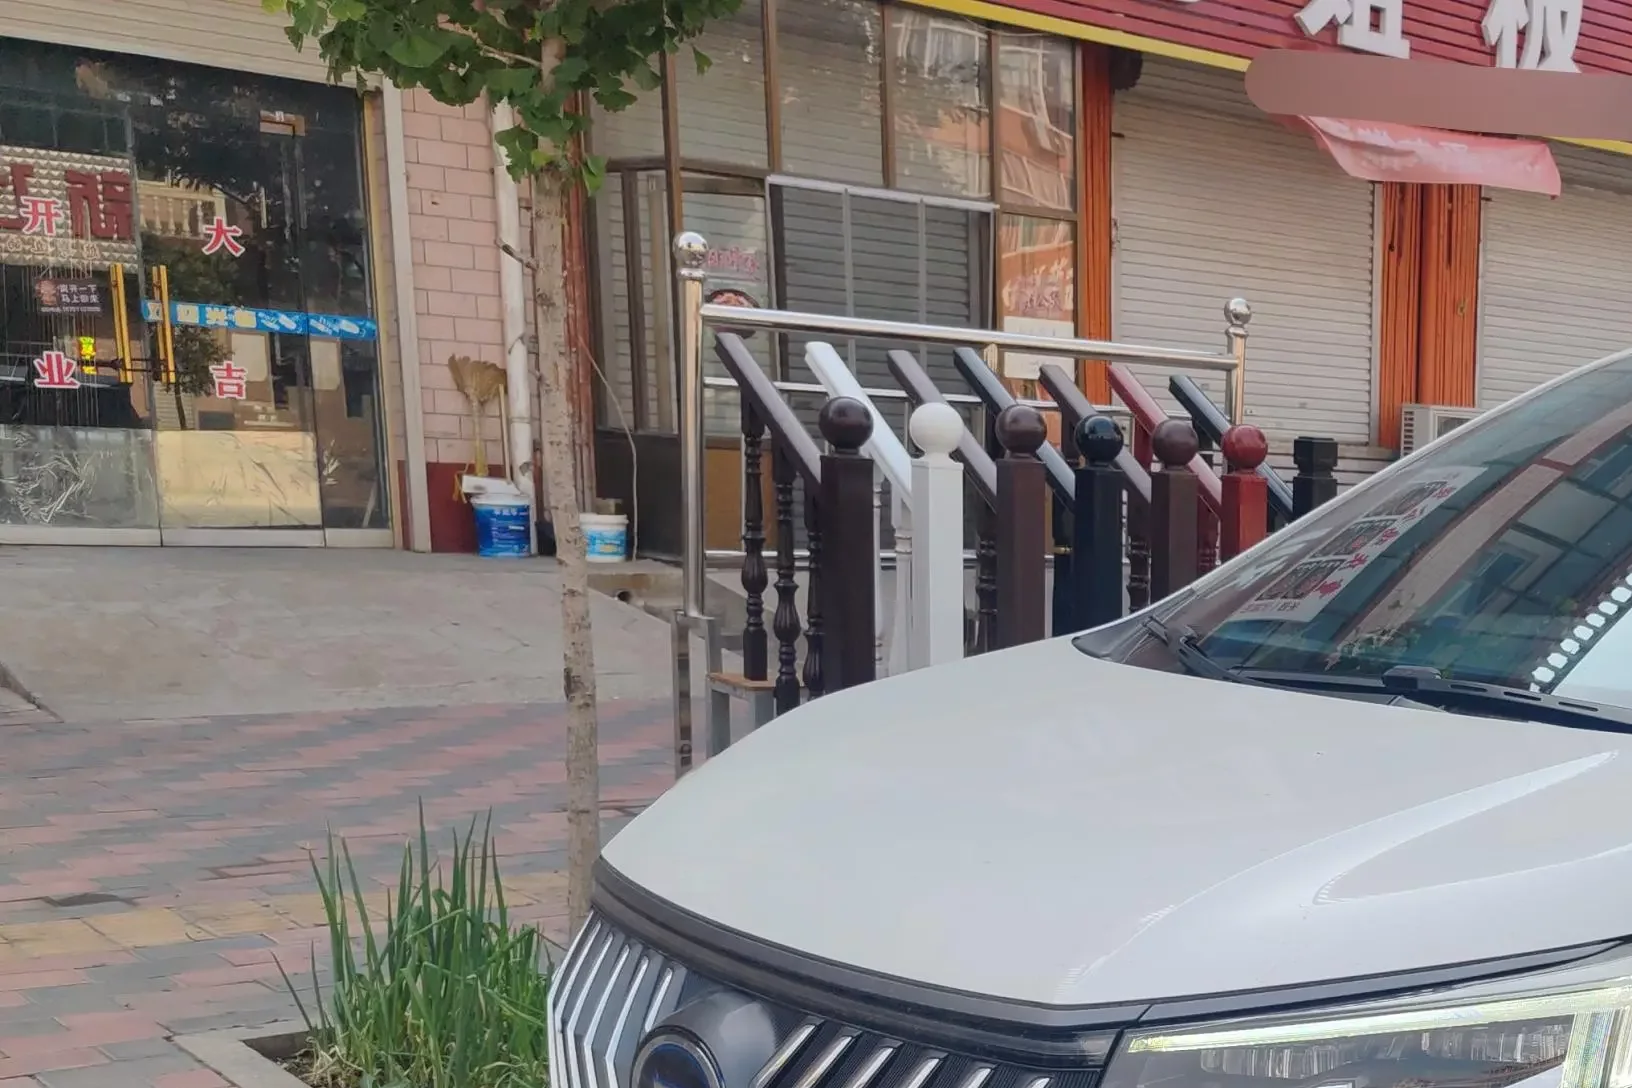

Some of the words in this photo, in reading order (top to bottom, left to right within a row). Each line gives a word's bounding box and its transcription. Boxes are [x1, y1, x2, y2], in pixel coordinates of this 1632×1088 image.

[20, 196, 64, 237] 开
[202, 216, 246, 257] 大
[33, 351, 81, 389] 业
[210, 361, 248, 400] 吉
